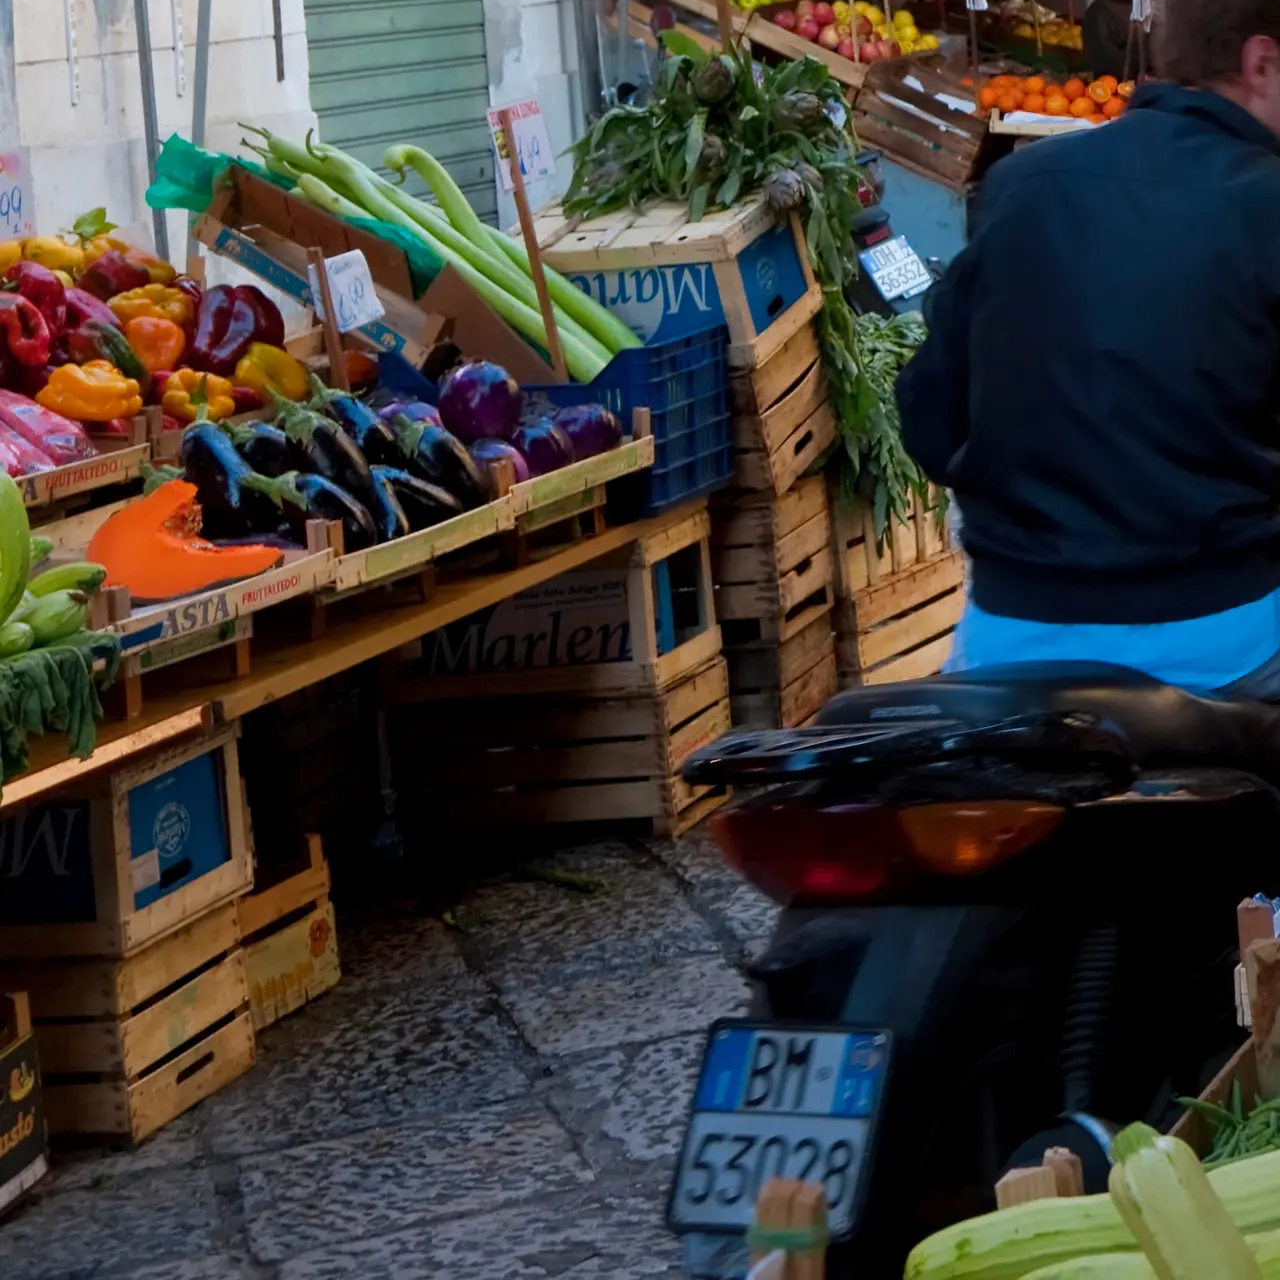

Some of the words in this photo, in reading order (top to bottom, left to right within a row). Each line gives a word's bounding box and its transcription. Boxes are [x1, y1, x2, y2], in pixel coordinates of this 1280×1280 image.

[872, 245, 897, 267] DH
[878, 259, 927, 293] 36352
[428, 605, 634, 676] Marlen
[743, 1035, 818, 1111] BM
[684, 1132, 854, 1210] 53028
